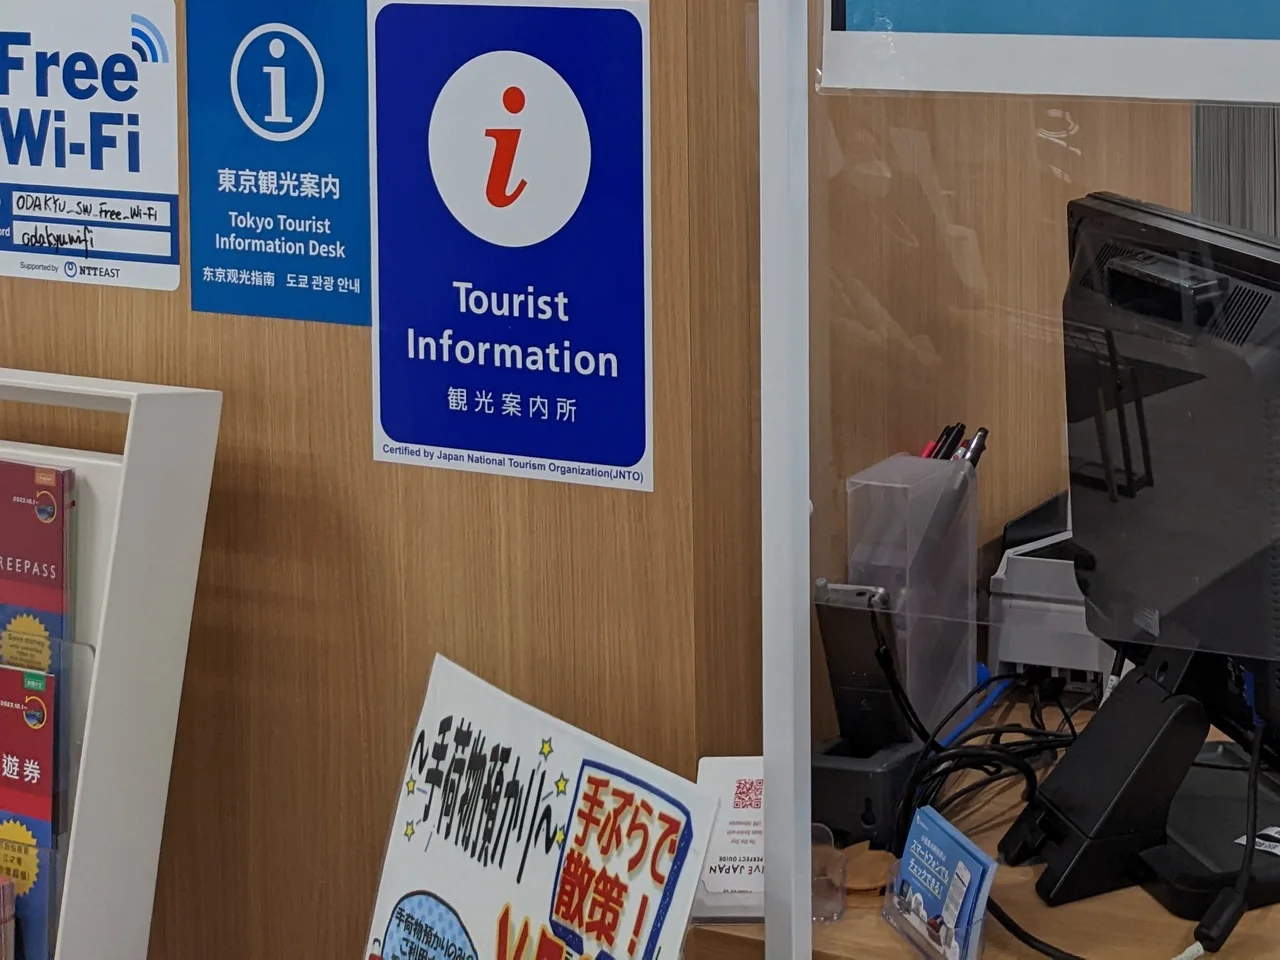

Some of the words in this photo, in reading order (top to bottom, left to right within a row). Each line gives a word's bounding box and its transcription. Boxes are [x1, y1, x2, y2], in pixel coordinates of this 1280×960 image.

[0, 31, 139, 101] Free
[0, 107, 141, 173] Wi-Fi
[217, 168, 340, 200] 東京観光案内
[228, 211, 274, 233] Tokyo
[277, 214, 331, 234] Tourist
[215, 233, 305, 255] Information
[309, 240, 346, 259] Desk
[20, 261, 50, 271] Supported
[50, 264, 59, 273] by
[203, 266, 275, 287] 东京观光指南
[286, 273, 309, 288] 도쿄
[312, 275, 334, 292] 관광
[337, 278, 360, 294] 안내
[452, 280, 569, 322] Tourist
[407, 328, 619, 378] Information
[447, 386, 577, 423] 観光案内所
[382, 443, 421, 457] Certified
[423, 447, 435, 460] by
[437, 450, 465, 464] Japan
[467, 453, 506, 467] National
[508, 457, 546, 471] Tourism
[548, 462, 644, 484] Organization(JNTO)
[0, 556, 56, 580] REEPASS
[574, 775, 683, 886] 手ぶらで
[709, 864, 745, 874] JAPAN
[748, 864, 764, 875] IVE
